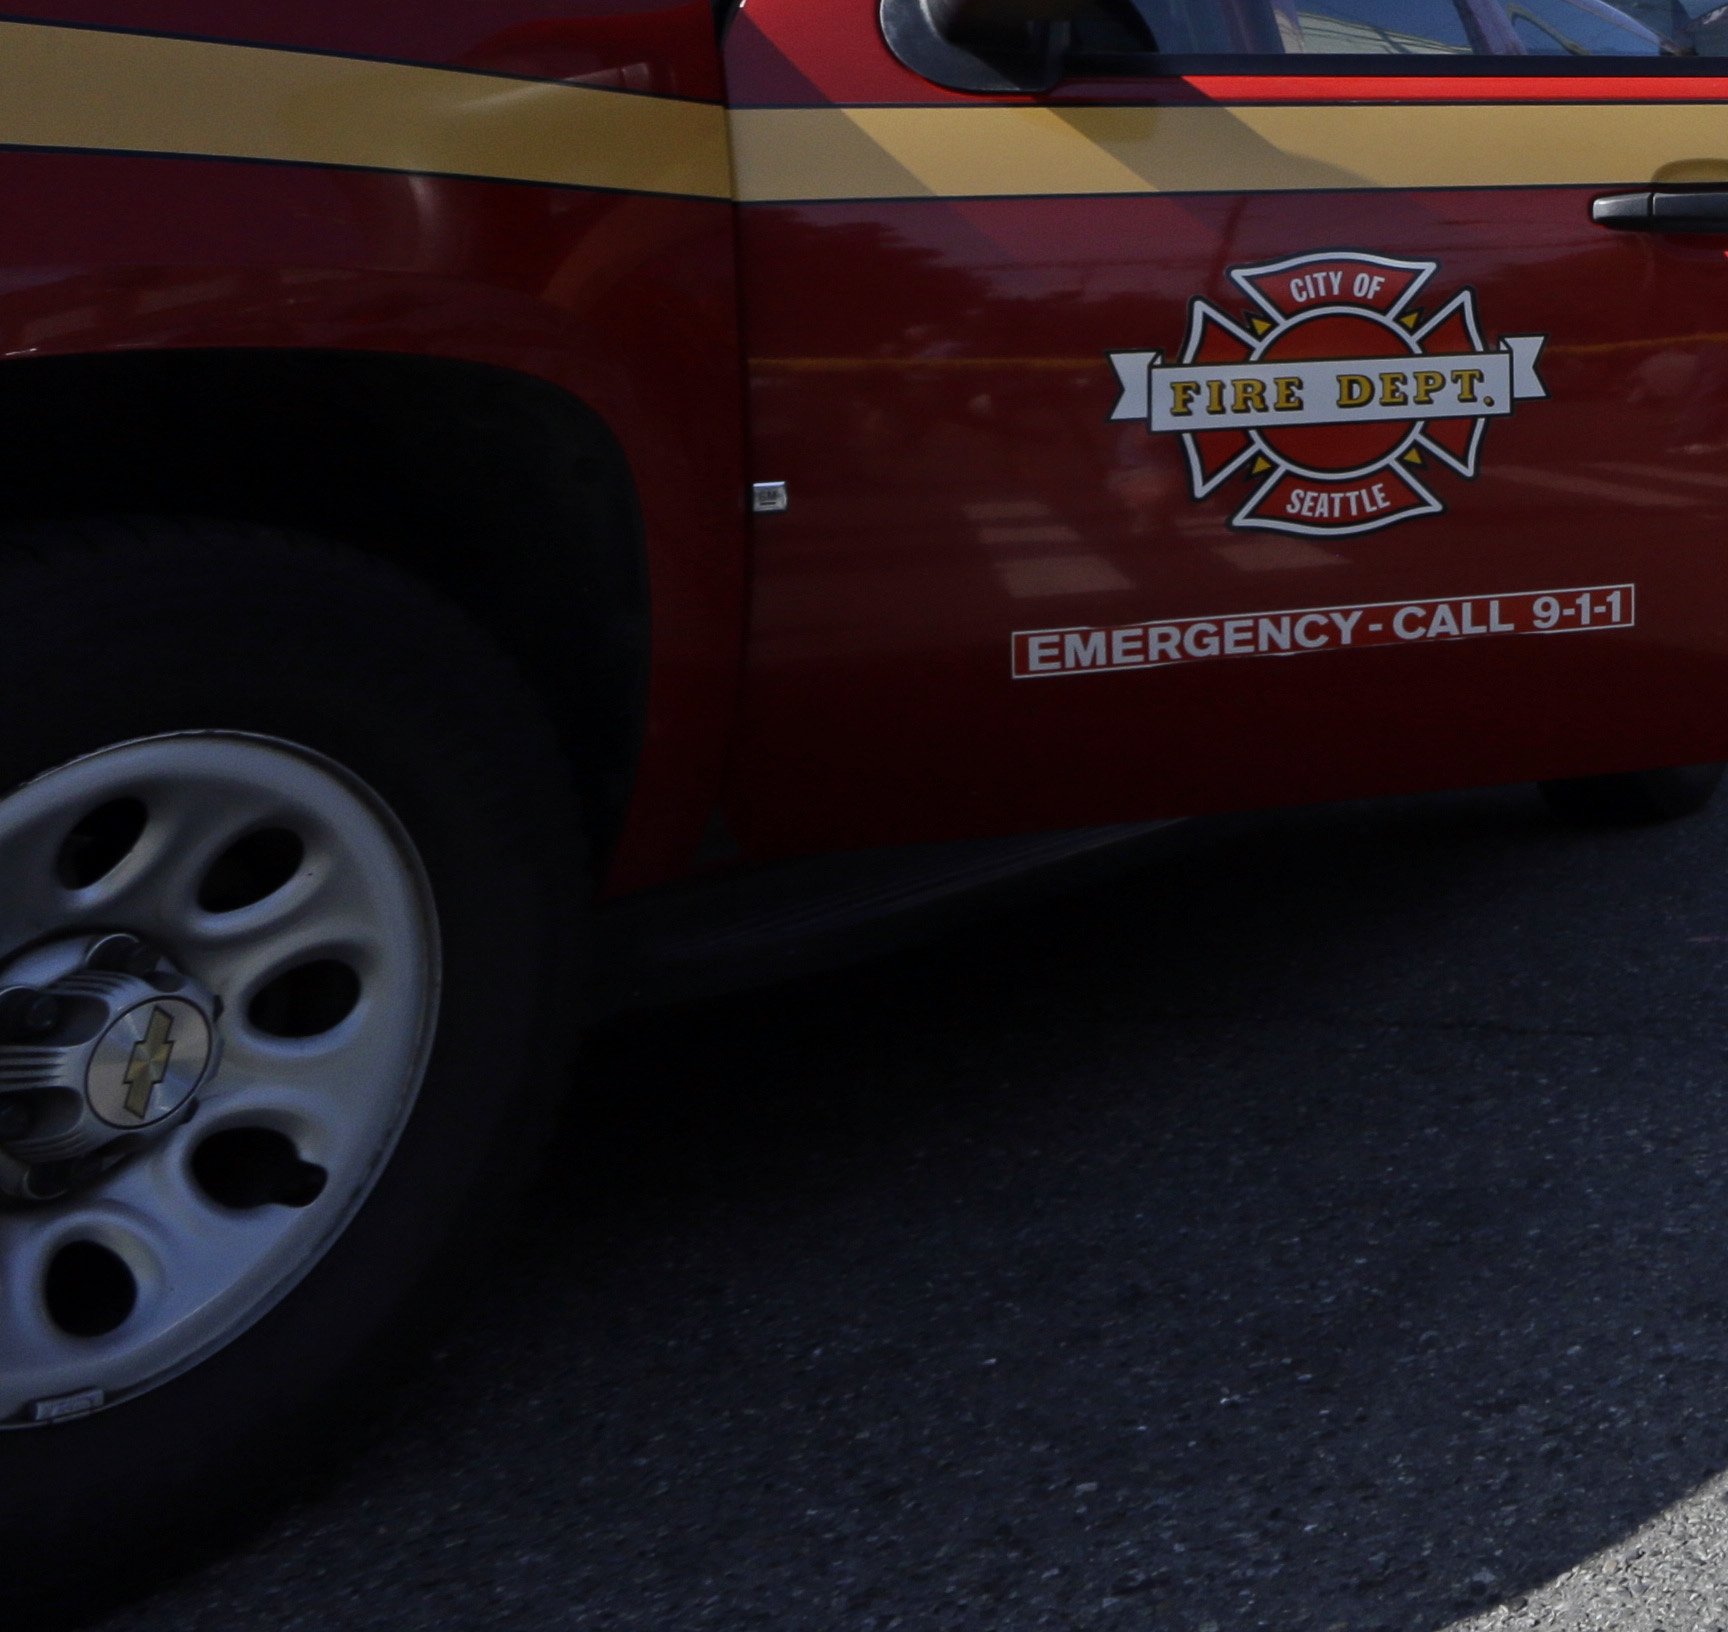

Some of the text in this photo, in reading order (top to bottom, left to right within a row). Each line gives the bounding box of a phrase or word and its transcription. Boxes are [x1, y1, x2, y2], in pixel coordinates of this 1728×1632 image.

[1289, 270, 1386, 302] CITY OF
[1170, 369, 1495, 417] FIRE DEPT.
[1286, 483, 1391, 518] SEATTLE
[1532, 590, 1621, 629] 9-1-1
